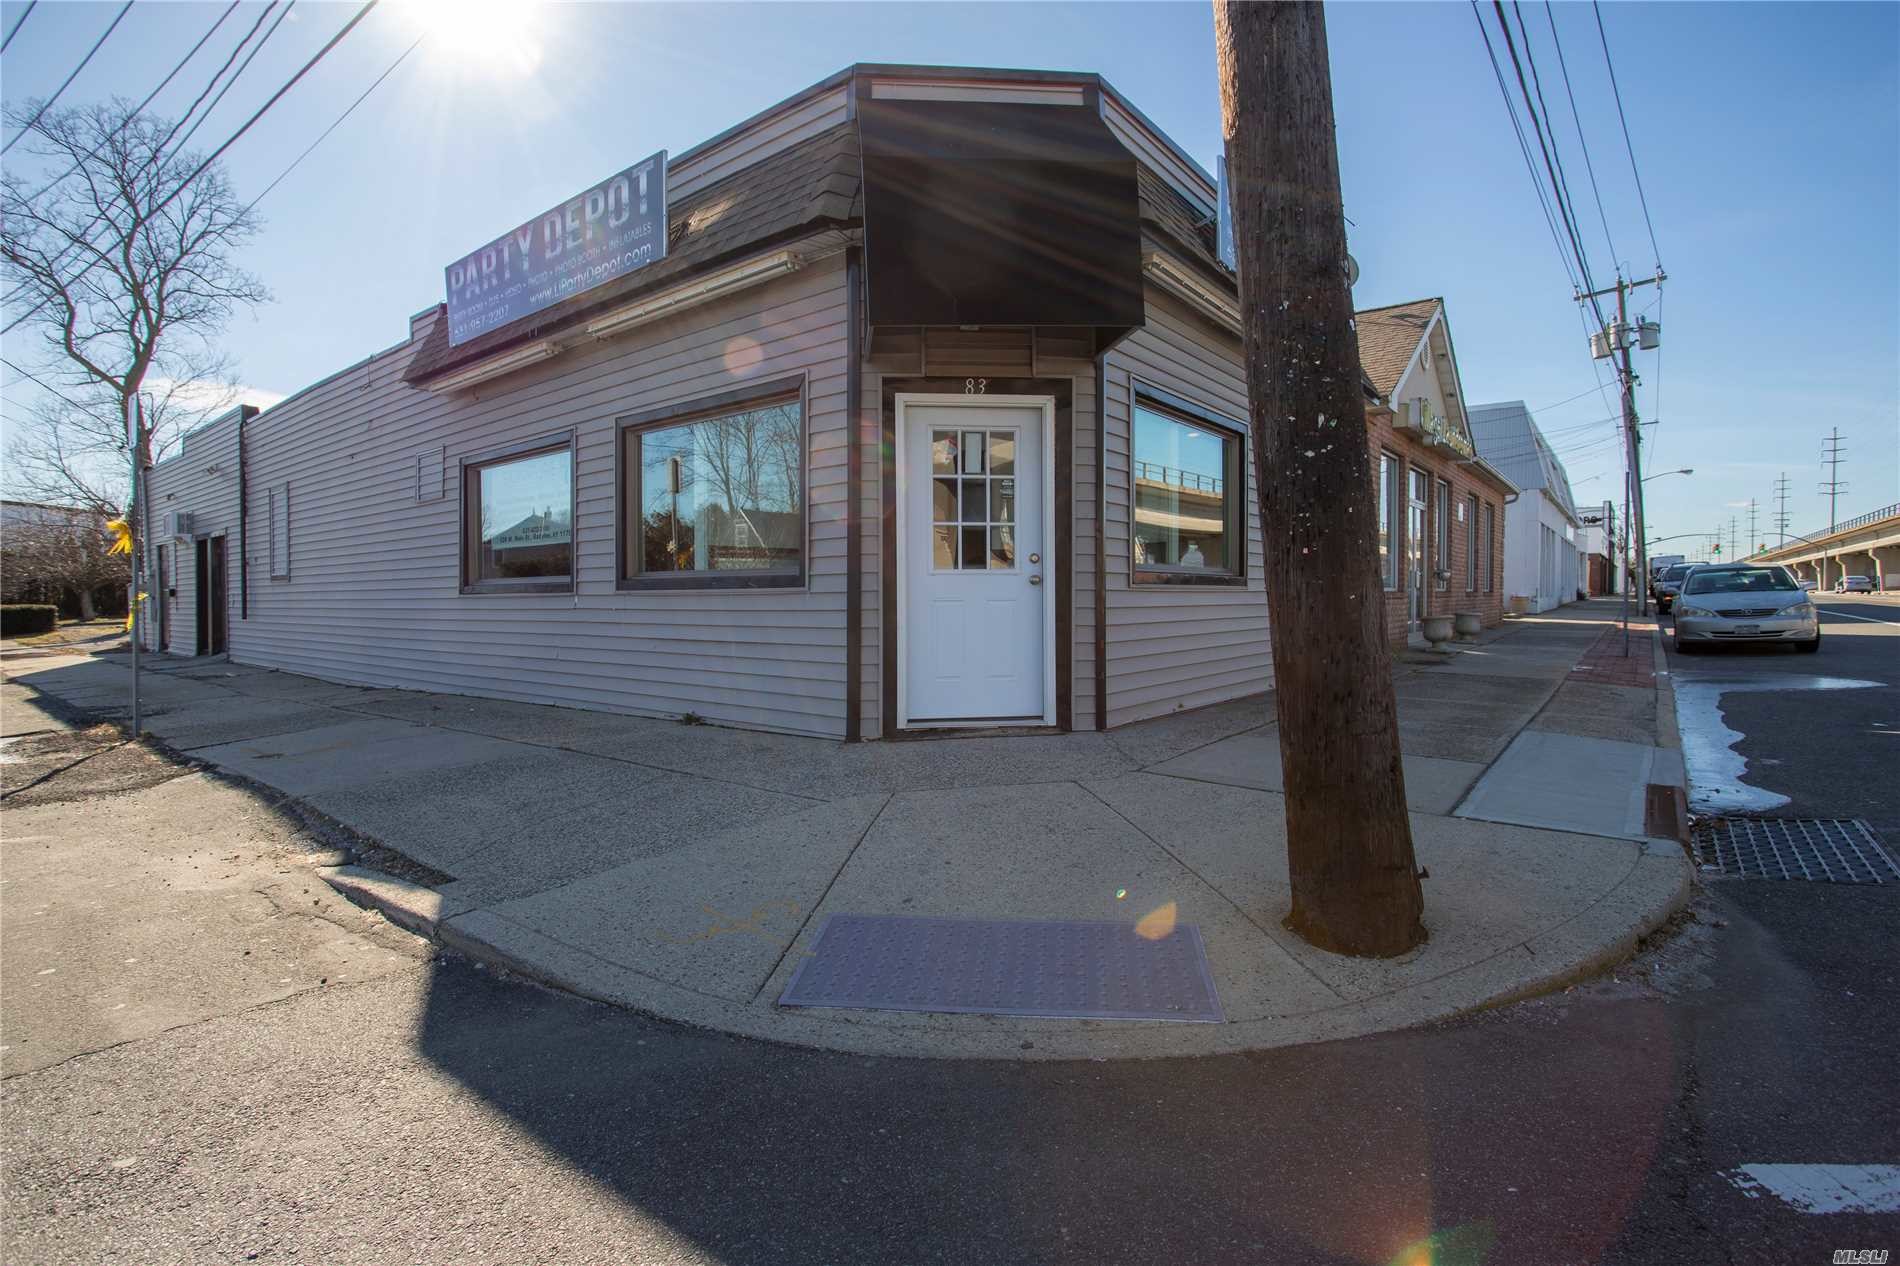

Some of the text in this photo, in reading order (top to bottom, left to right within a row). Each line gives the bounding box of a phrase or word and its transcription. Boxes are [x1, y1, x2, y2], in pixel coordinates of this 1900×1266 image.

[451, 158, 655, 305] PARTY DEPOT
[965, 378, 986, 394] 83
